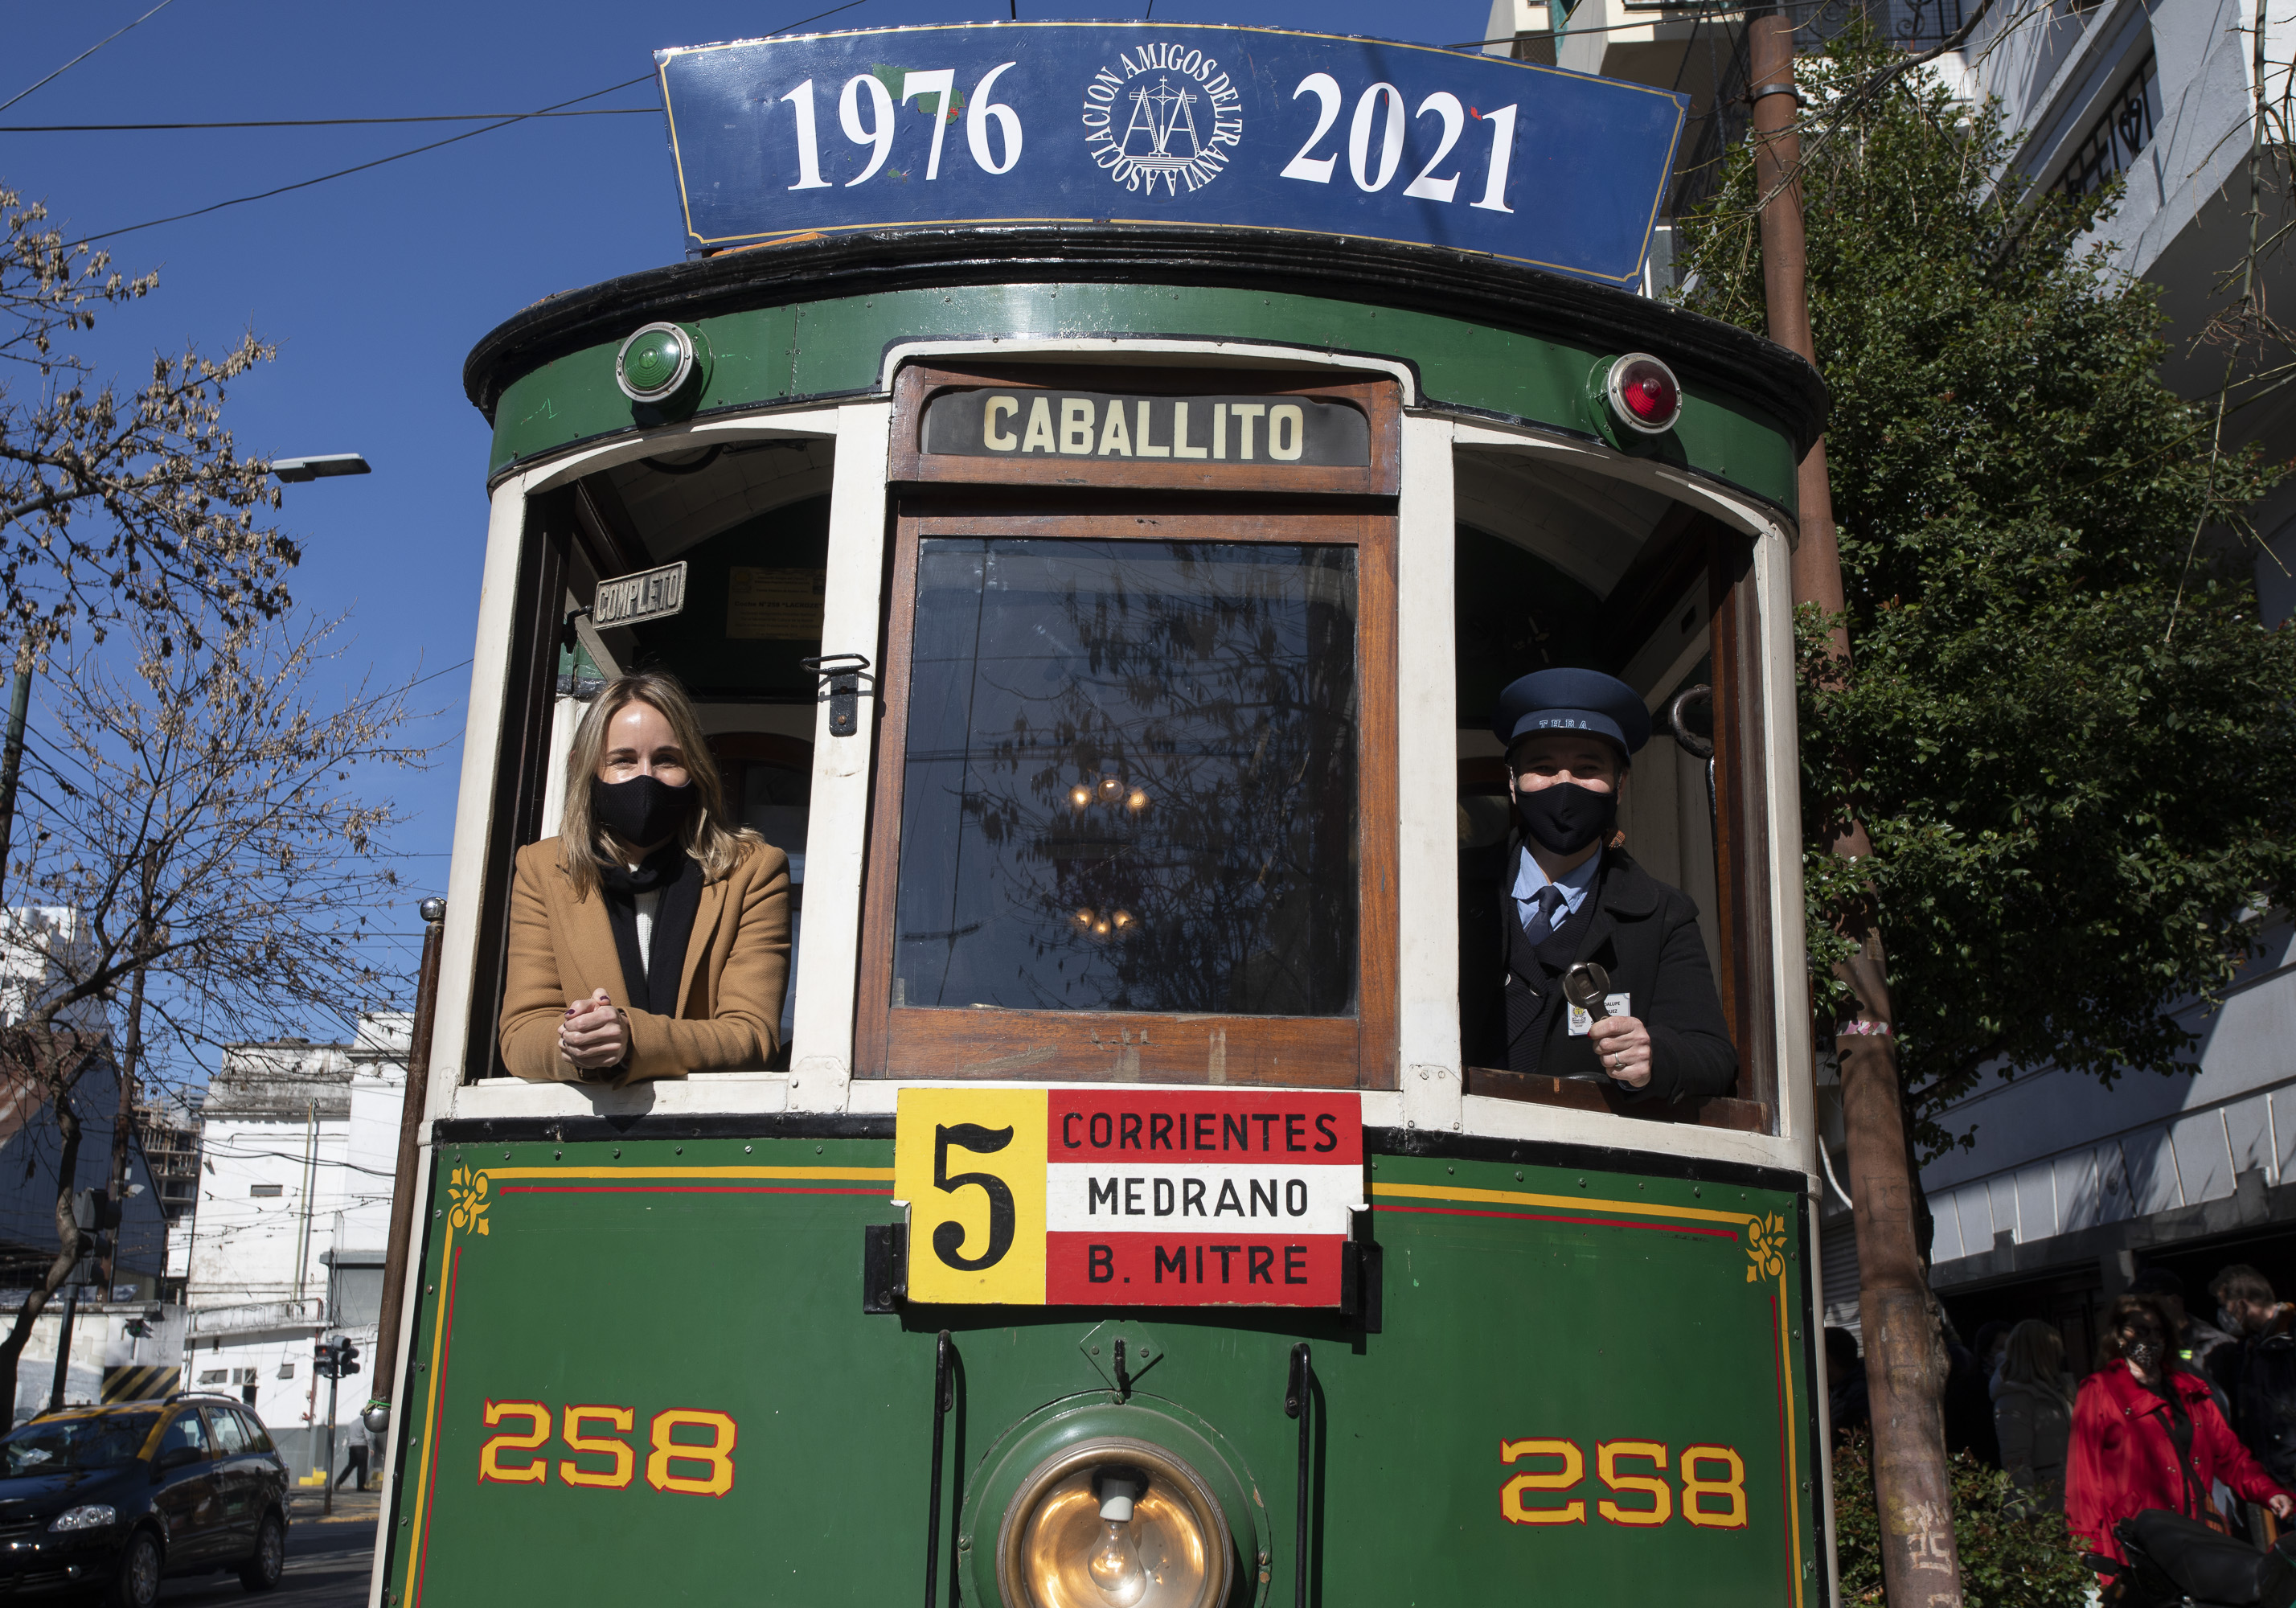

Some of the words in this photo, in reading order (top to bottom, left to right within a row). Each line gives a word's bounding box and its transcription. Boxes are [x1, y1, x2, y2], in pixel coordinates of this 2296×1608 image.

[1120, 43, 1217, 81] AMIGOS
[1203, 72, 1241, 119] DEL
[781, 61, 1023, 191] 1976
[1082, 66, 1160, 195] ASOCIACION
[1162, 118, 1243, 196] TRANVIA
[1279, 72, 1517, 214] 2021
[983, 396, 1303, 461] CABALLITO
[596, 569, 680, 623] COMPLETO
[1062, 1112, 1339, 1153] CORRIENTES
[933, 1122, 1015, 1272] 5
[1089, 1177, 1308, 1218] MEDRANO
[1089, 1244, 1130, 1284] B.
[1154, 1245, 1309, 1286] MITRE
[478, 1397, 738, 1499] 258
[1499, 1437, 1749, 1530] 258
